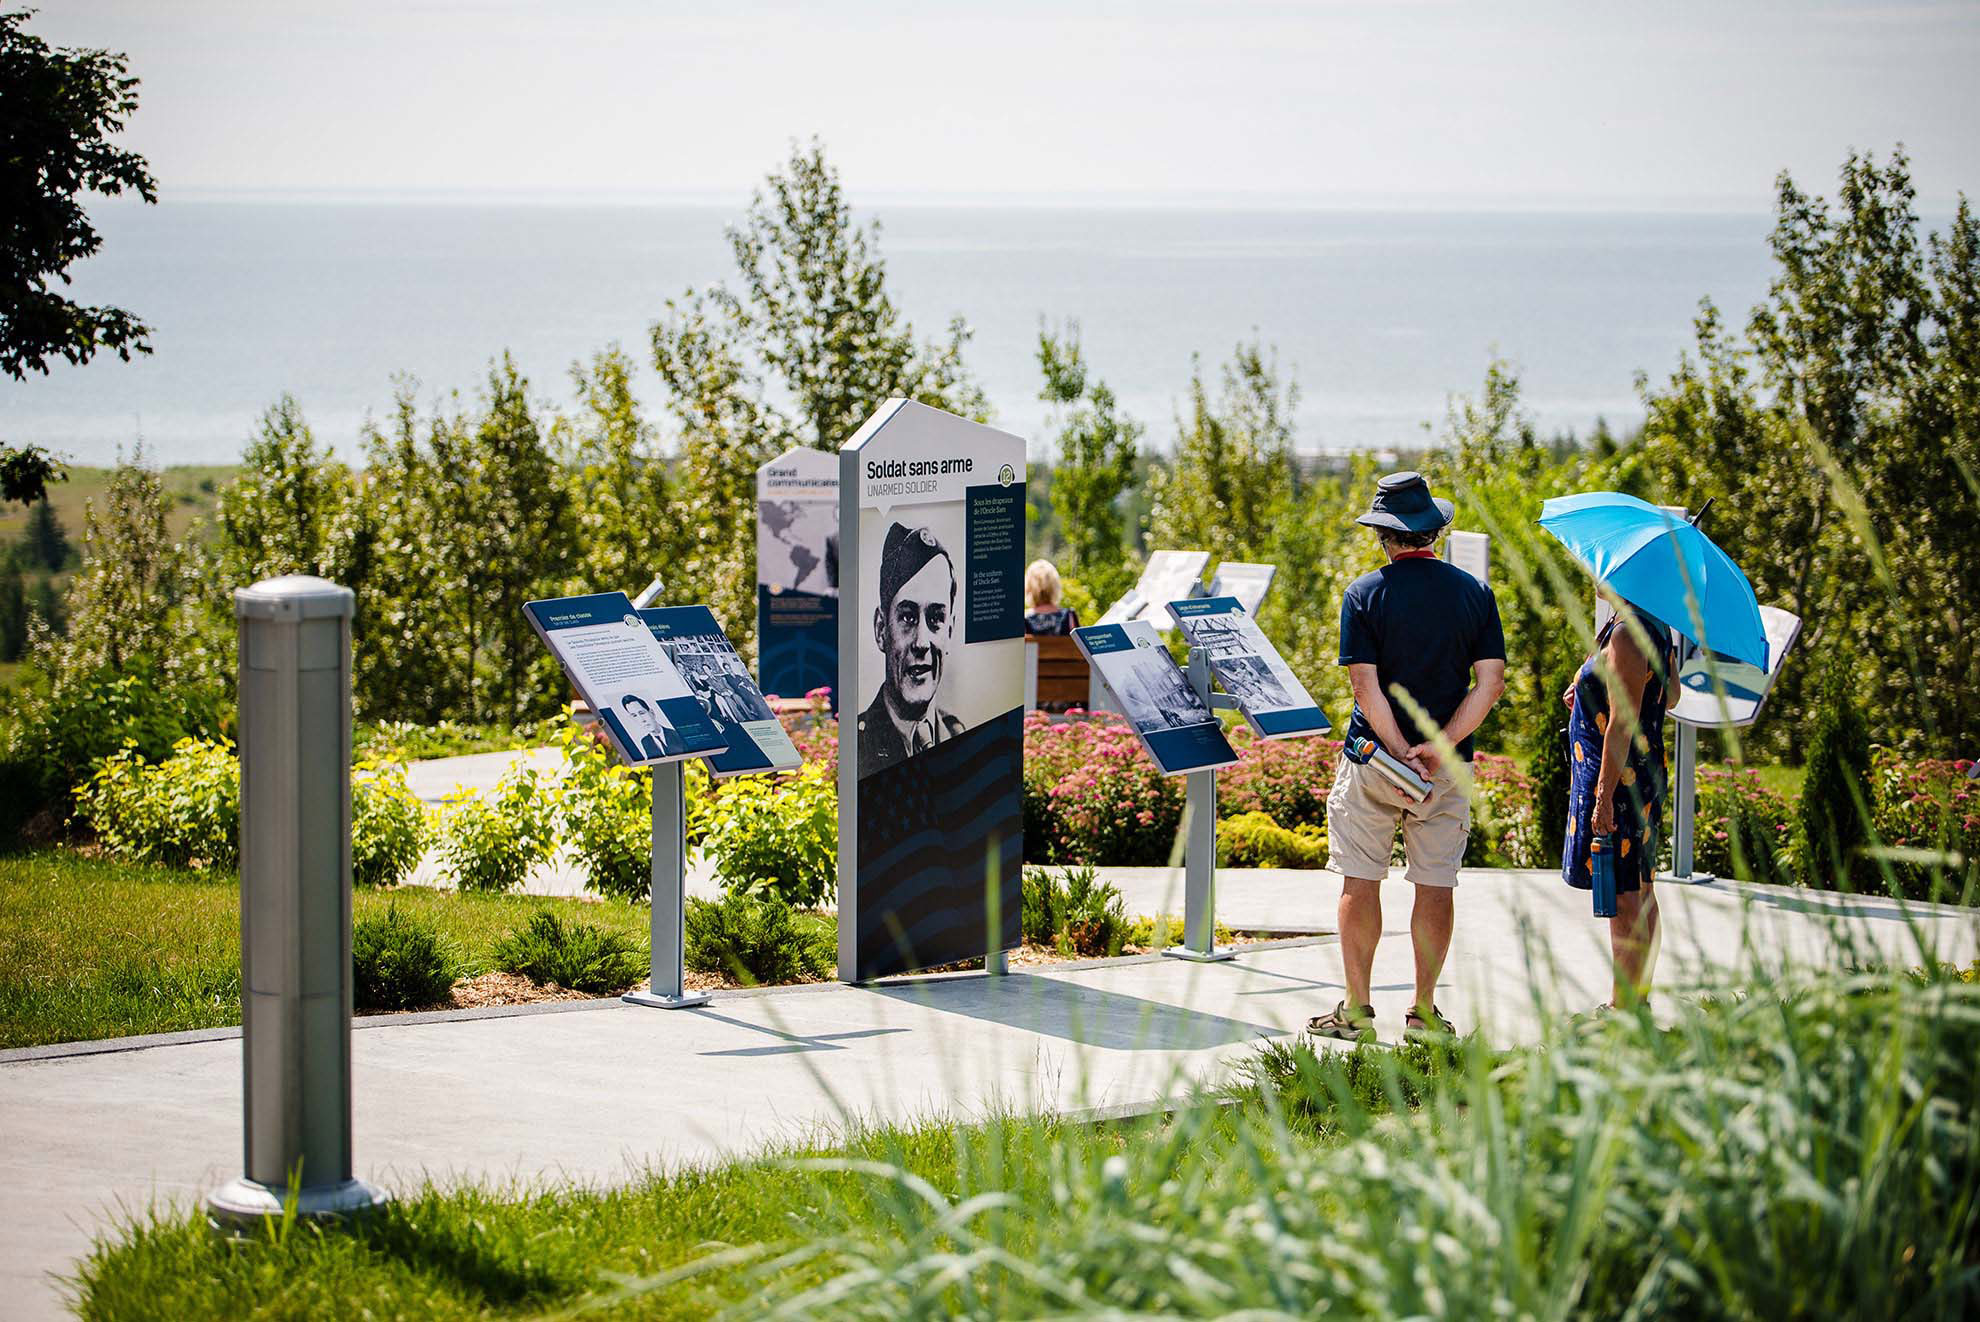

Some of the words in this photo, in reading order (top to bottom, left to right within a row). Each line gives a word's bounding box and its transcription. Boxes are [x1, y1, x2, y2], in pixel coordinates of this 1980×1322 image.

[767, 467, 797, 477] Grand
[867, 459, 906, 479] Soldat
[909, 460, 938, 476] sans
[941, 458, 973, 474] arme
[1002, 471, 1011, 483] 12
[767, 478, 839, 488] communicate
[867, 482, 904, 497] UNARMED
[905, 480, 938, 495] SOLDIER
[549, 614, 569, 622] Premier
